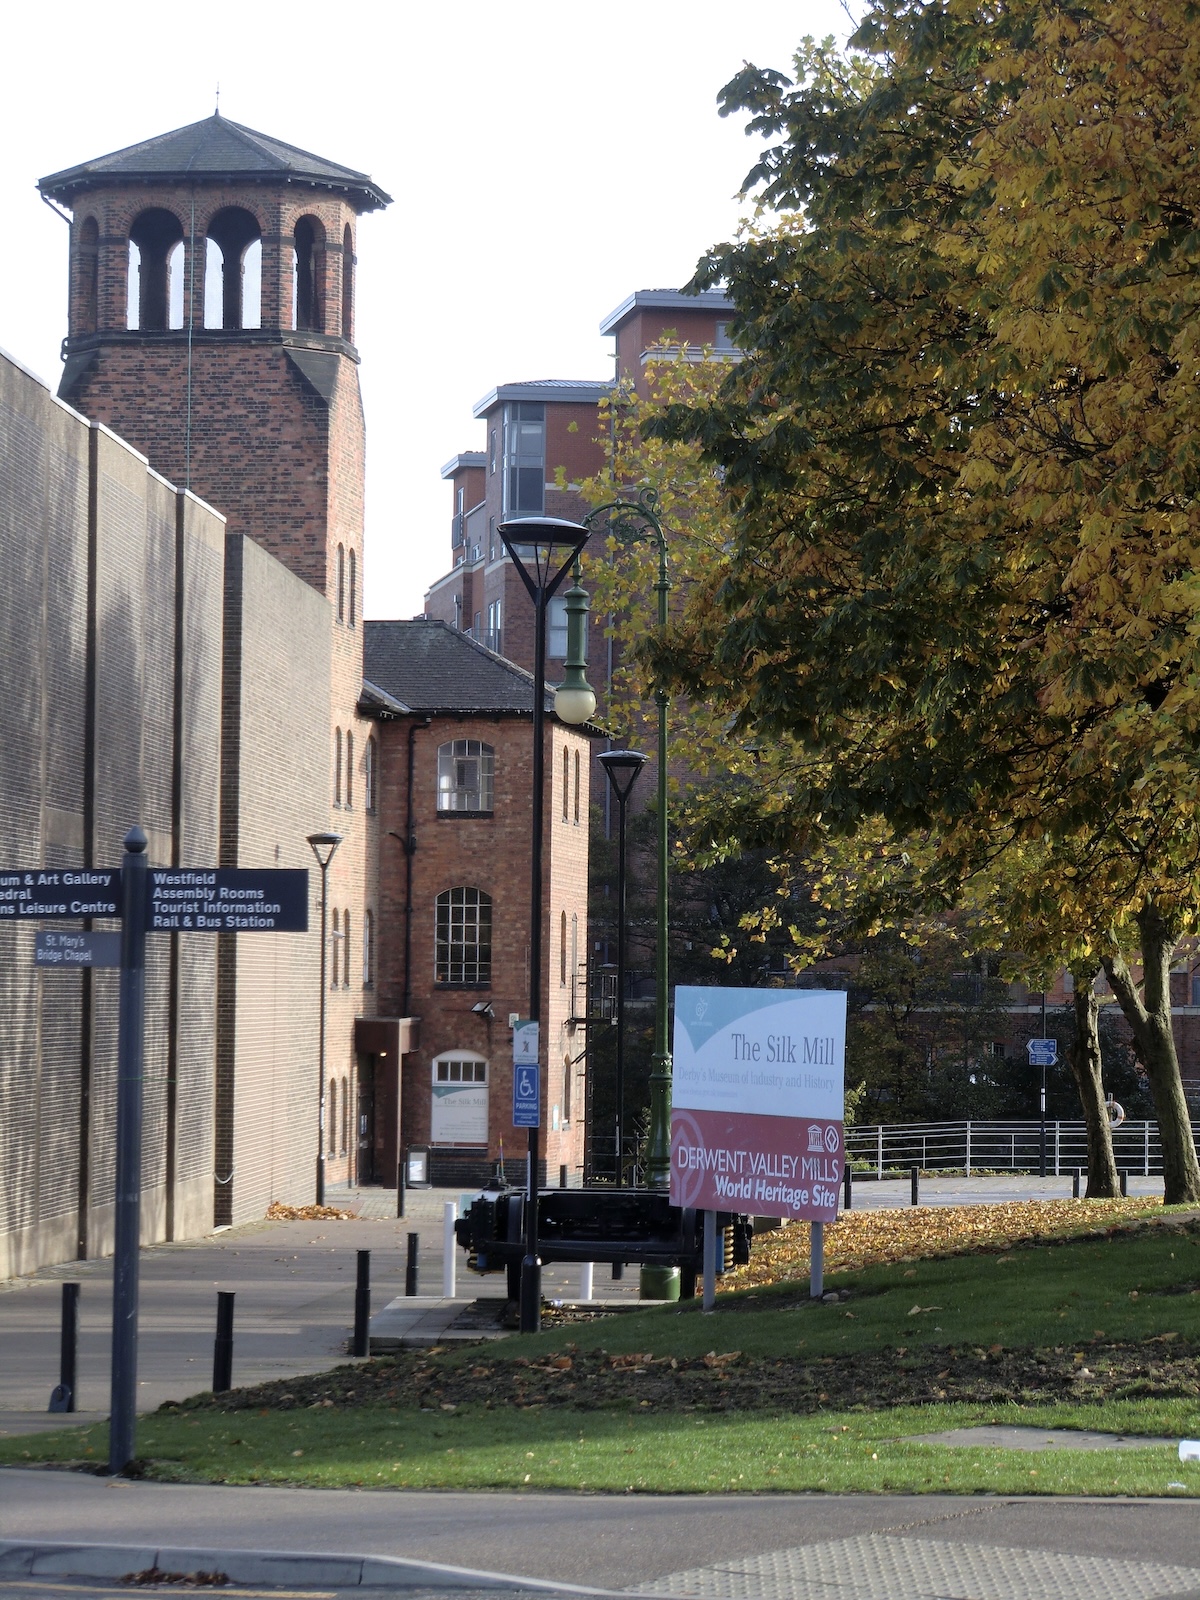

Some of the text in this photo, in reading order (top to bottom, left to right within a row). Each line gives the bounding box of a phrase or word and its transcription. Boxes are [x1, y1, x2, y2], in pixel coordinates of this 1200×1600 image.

[24, 874, 34, 885] &
[38, 873, 60, 885] Art
[63, 873, 111, 887] Gallery
[153, 873, 216, 885] Westfield
[153, 887, 264, 901] Assembly Rooms
[20, 902, 67, 914] Leisure
[71, 901, 116, 913] Centre
[153, 902, 280, 913] Tourist Information
[153, 916, 275, 928] Rail & Bus Station
[45, 935, 85, 949] St. Mary's
[37, 950, 92, 962] Bridge Chapel
[731, 1033, 835, 1066] The Silk Mill
[678, 1066, 835, 1093] Derby's Museum of Industry and History
[473, 1098, 487, 1106] Mill
[515, 1102, 537, 1110] PARKING
[678, 1146, 839, 1183] DERWENT VALLEY MILLS
[715, 1175, 836, 1211] World Heritage Site
